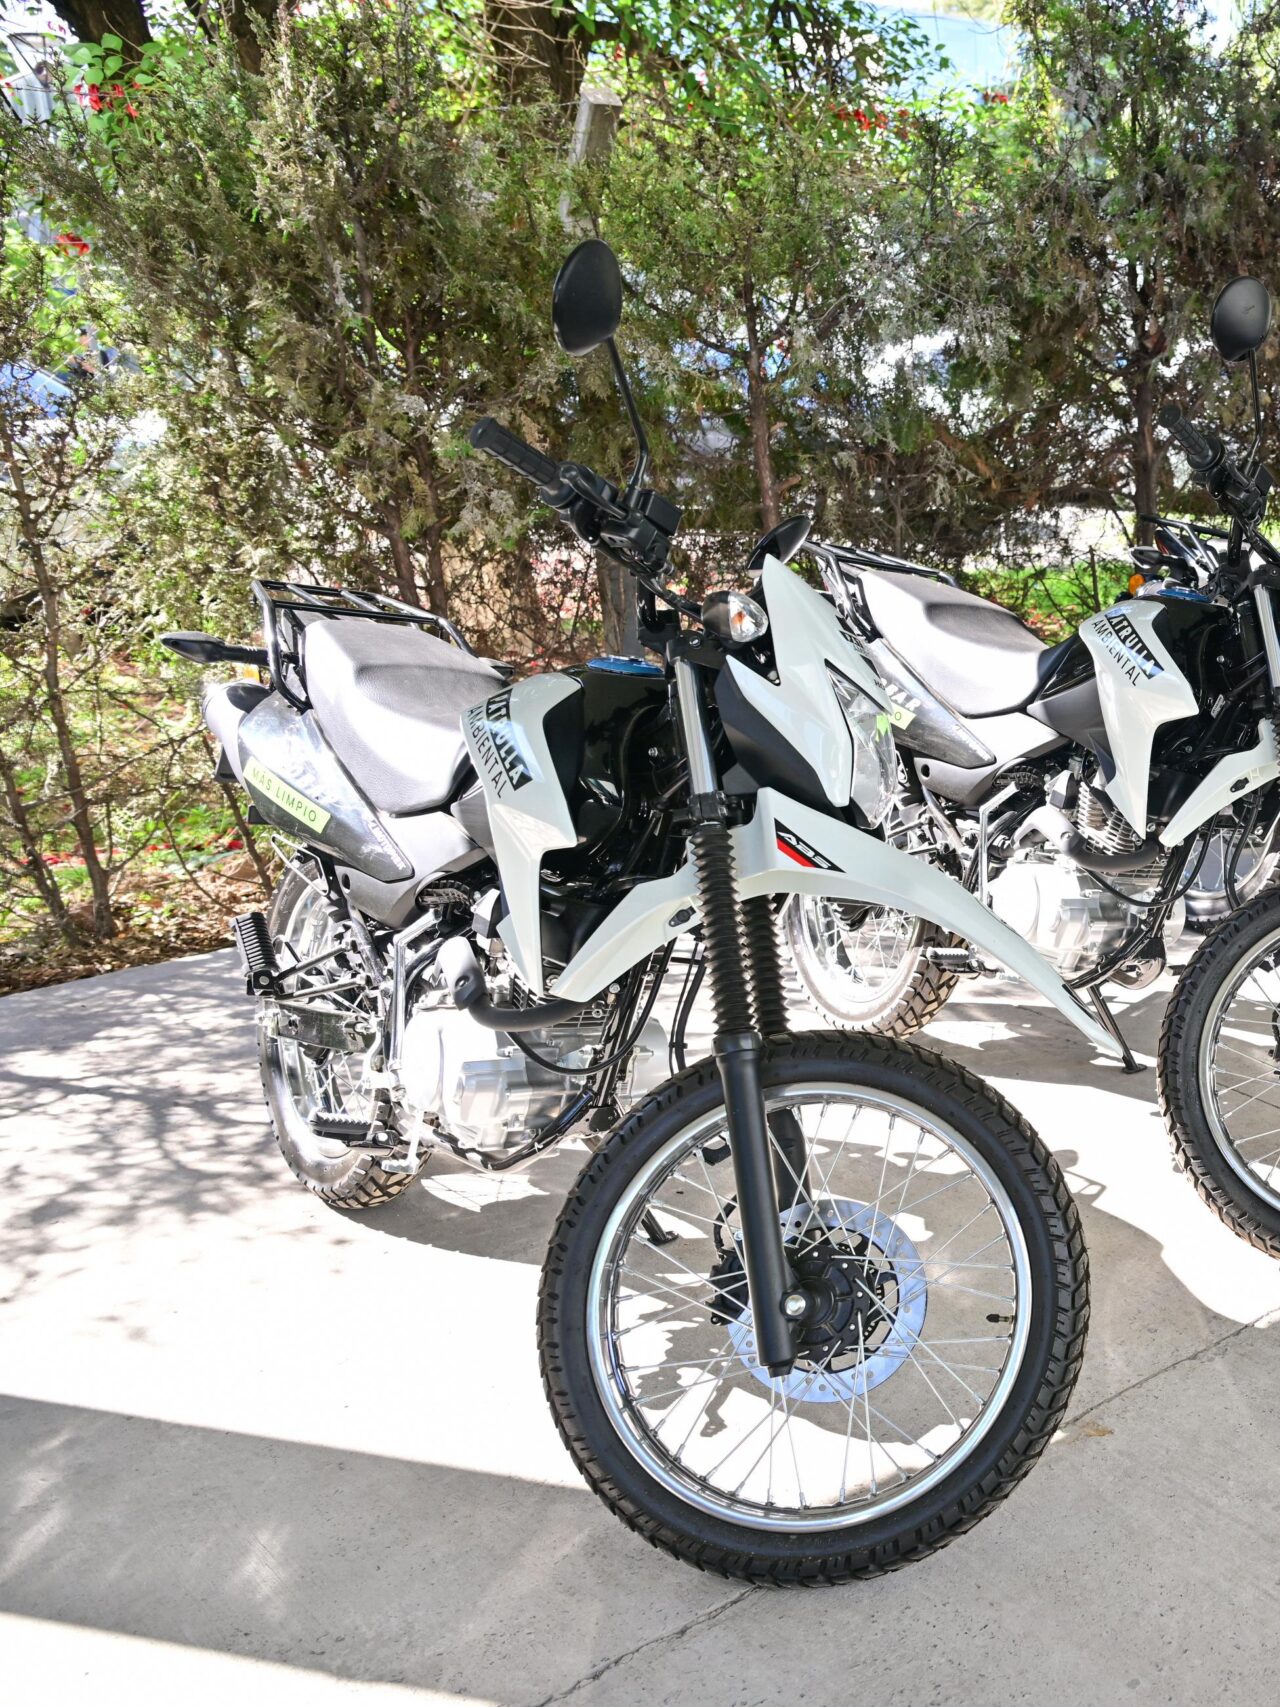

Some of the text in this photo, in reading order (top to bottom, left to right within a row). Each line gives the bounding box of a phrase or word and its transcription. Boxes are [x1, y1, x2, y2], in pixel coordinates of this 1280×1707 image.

[1091, 619, 1141, 687] AMBIENTAL
[467, 705, 507, 799] AMBIENTAL
[252, 766, 272, 791] MÁS
[275, 785, 318, 823] LIMPIO
[776, 831, 832, 869] ABS
